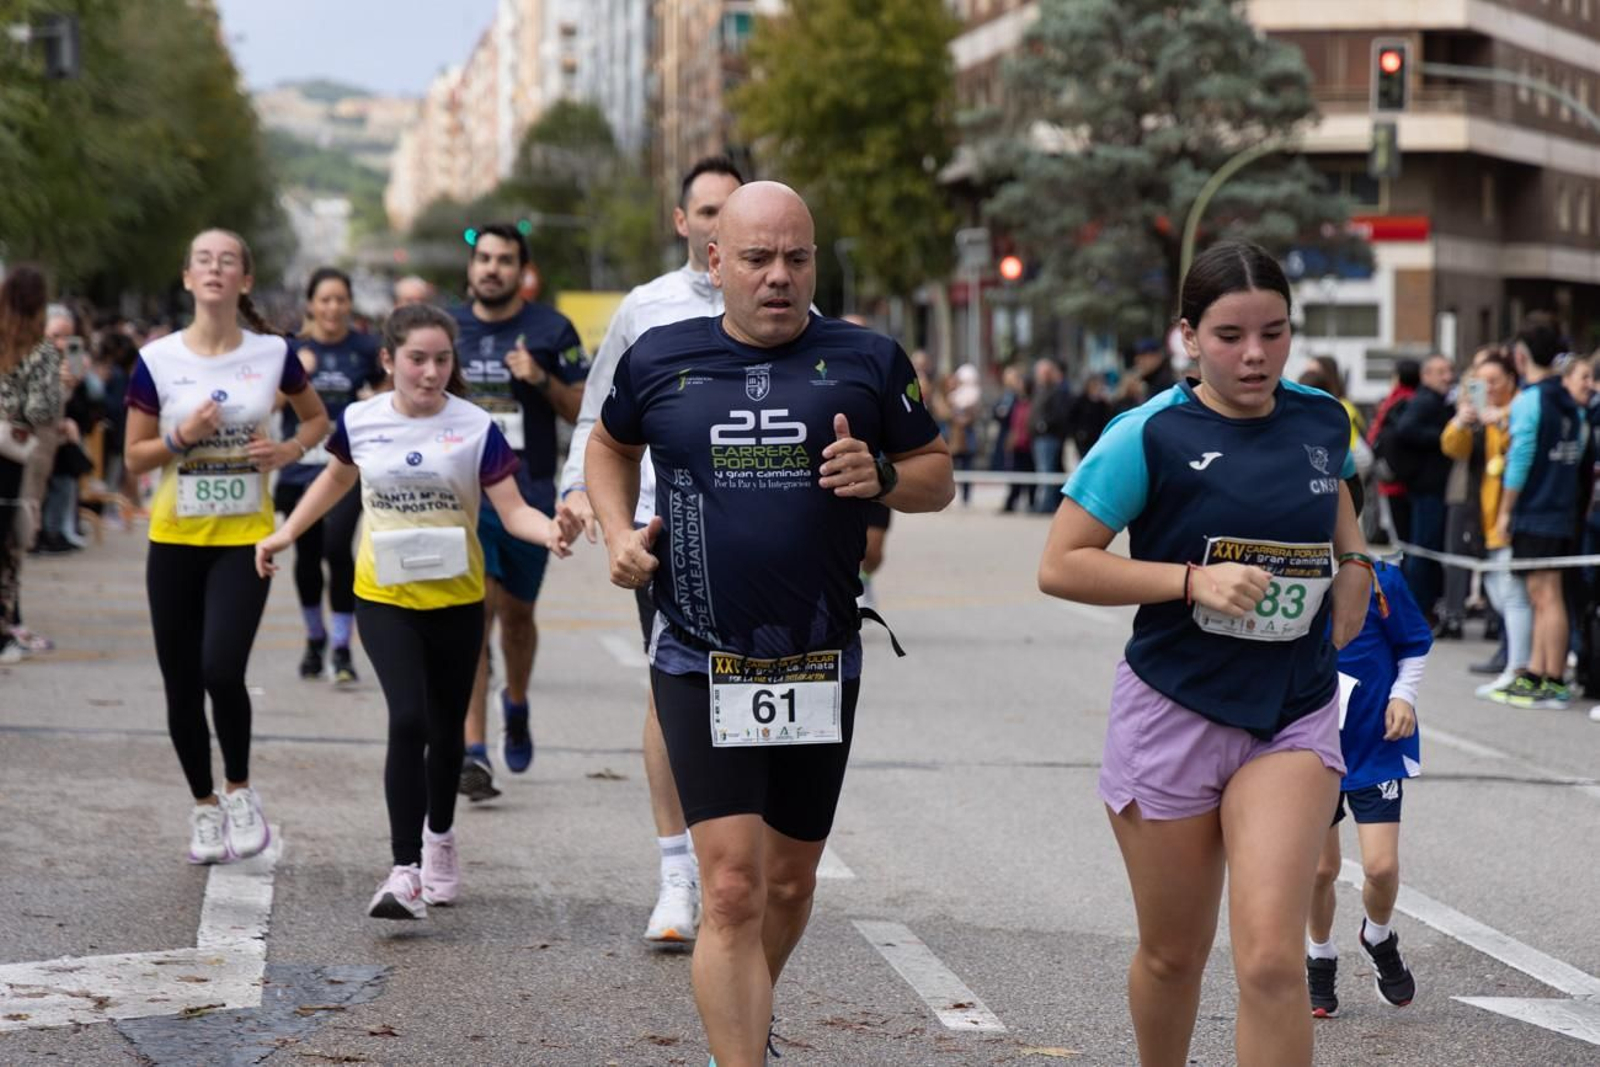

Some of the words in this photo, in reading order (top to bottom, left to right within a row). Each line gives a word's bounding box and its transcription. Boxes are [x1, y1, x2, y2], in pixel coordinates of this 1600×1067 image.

[710, 409, 807, 445] 25
[711, 446, 807, 457] CARRERA
[712, 457, 810, 469] POPULAR
[726, 470, 753, 478] gran
[757, 469, 812, 477] caminata
[195, 478, 246, 501] 850
[714, 479, 727, 488] Por
[729, 479, 736, 488] la
[738, 479, 751, 488] Paz
[759, 479, 767, 488] la
[673, 491, 686, 569] CATALINA
[1212, 542, 1245, 561] XXV
[1246, 545, 1292, 557] CARRERA
[1257, 555, 1284, 564] gran
[1290, 557, 1329, 566] caminata
[752, 688, 795, 724] 61
